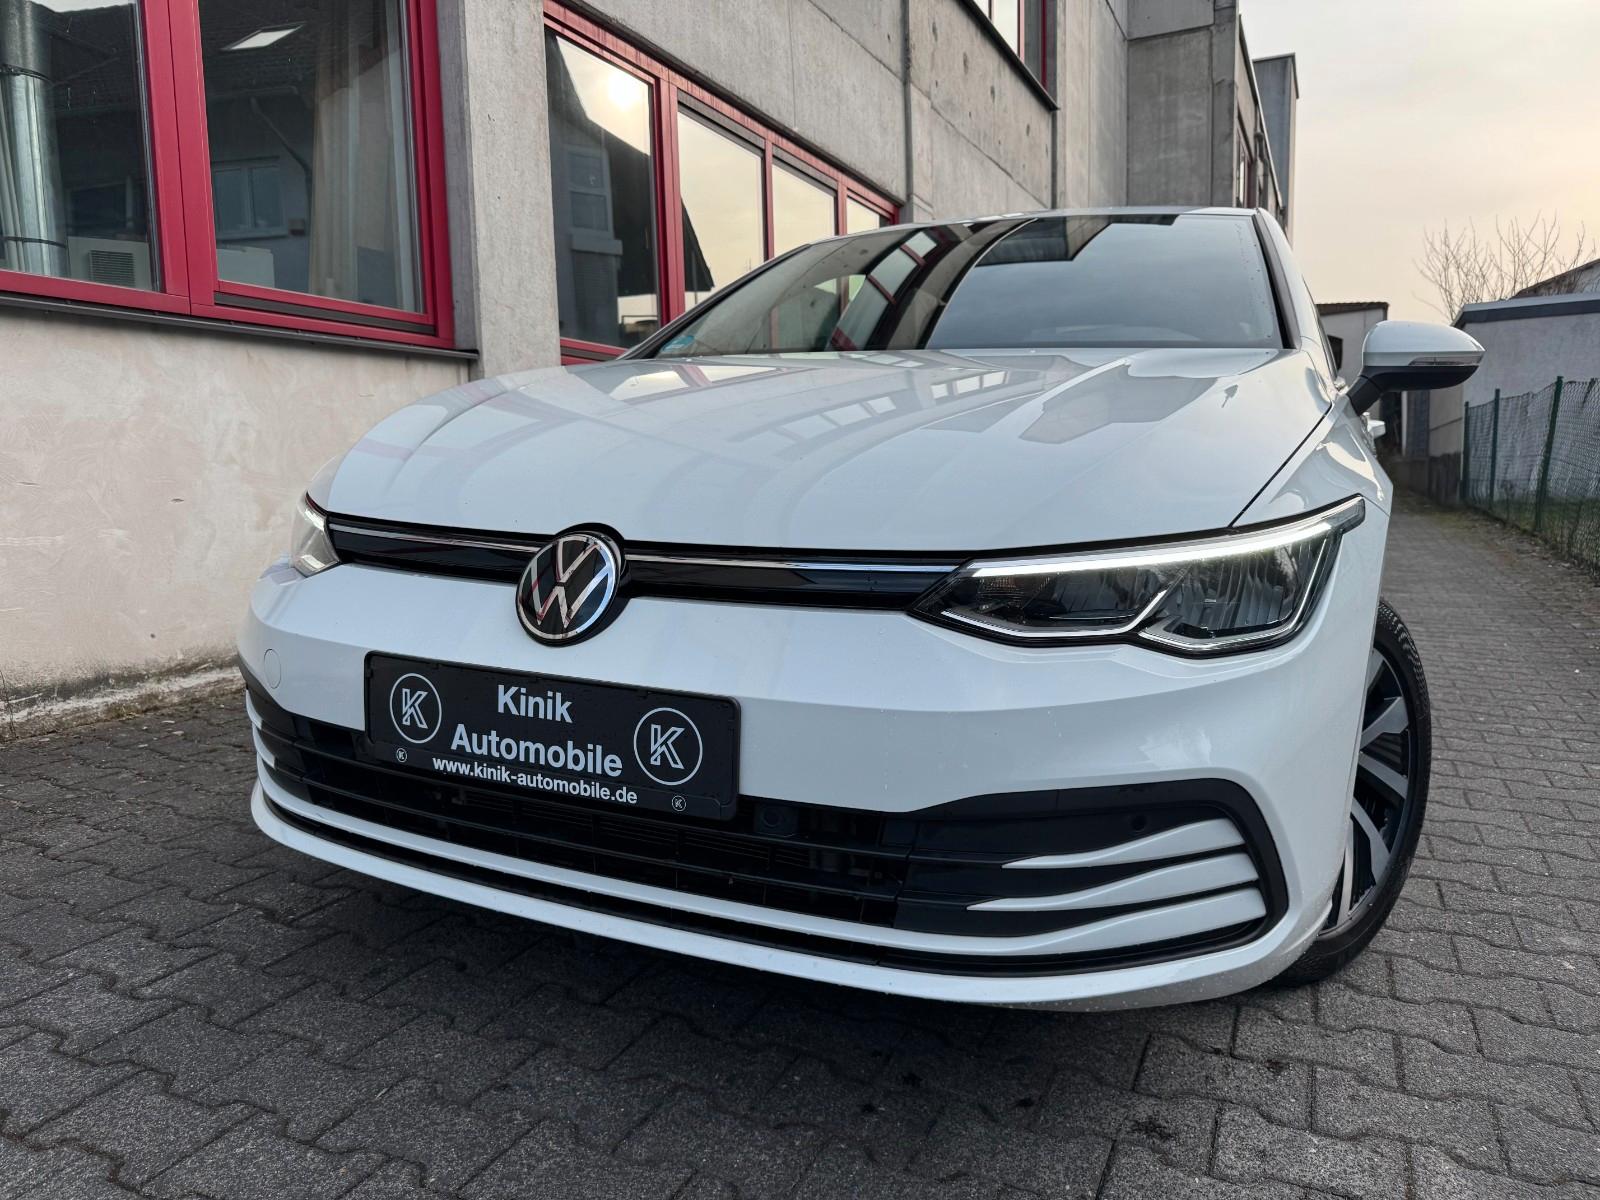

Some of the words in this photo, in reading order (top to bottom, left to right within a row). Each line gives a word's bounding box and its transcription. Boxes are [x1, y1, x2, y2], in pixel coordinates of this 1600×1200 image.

[529, 538, 611, 629] VW
[498, 685, 573, 723] Kinik
[450, 723, 623, 778] Automobile
[432, 757, 638, 804] www.kinik-automobile.de
